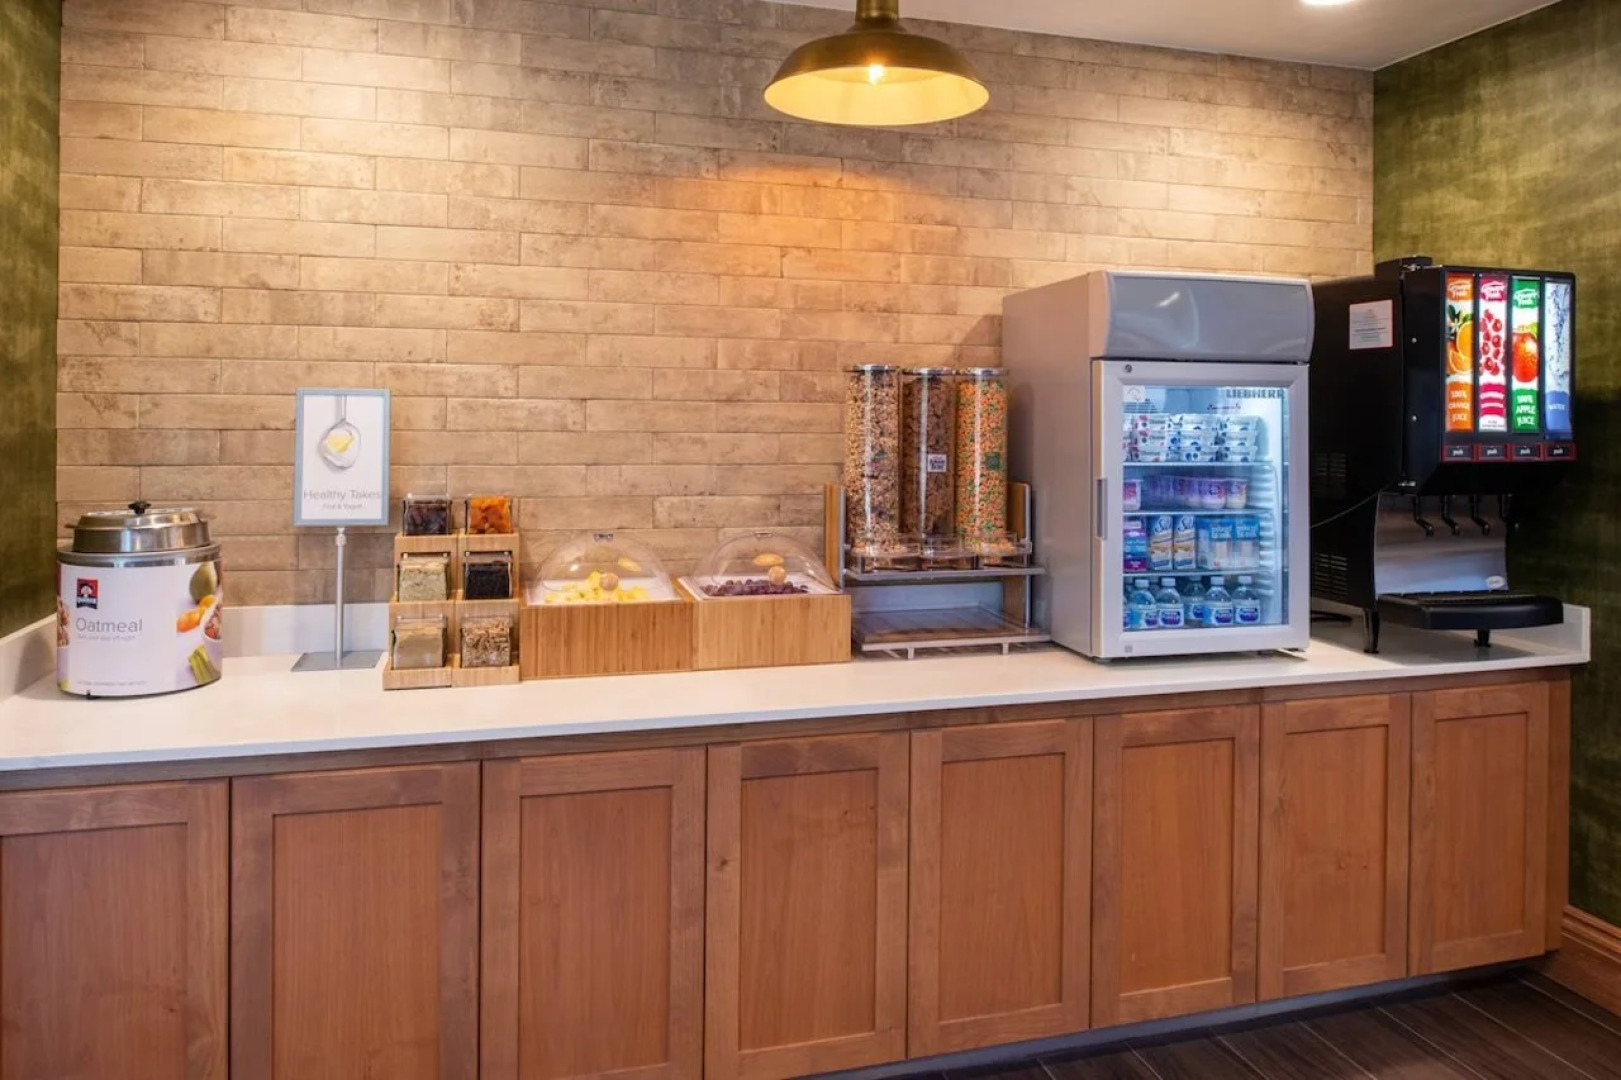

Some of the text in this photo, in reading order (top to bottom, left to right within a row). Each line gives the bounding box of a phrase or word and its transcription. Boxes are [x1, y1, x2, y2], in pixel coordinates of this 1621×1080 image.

[1516, 404, 1536, 415] APPLE
[1516, 416, 1535, 426] JUICE
[303, 489, 381, 502] Healthy Takes
[76, 617, 143, 633] Oatmeal
